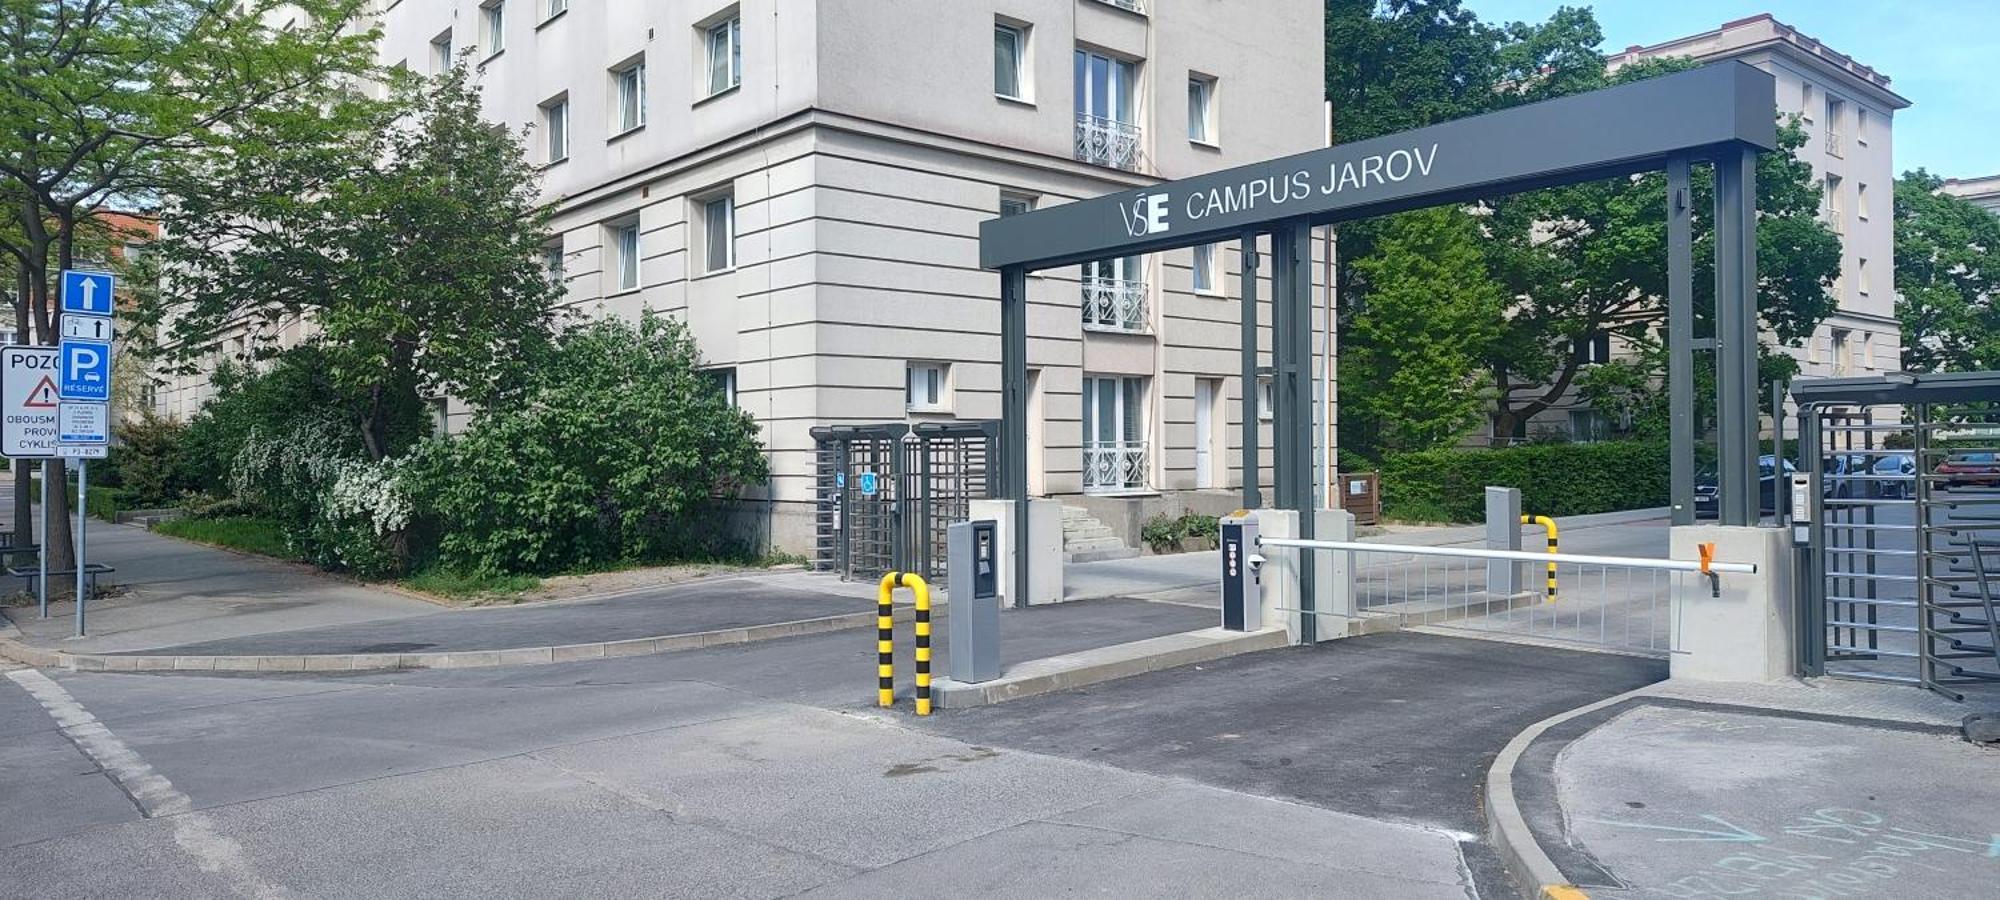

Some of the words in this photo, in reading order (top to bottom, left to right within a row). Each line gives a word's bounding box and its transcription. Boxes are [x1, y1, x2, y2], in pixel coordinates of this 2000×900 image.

[1120, 193, 1169, 237] VŠE
[1186, 170, 1311, 221] CAMPUS
[1321, 144, 1439, 196] JAROV
[70, 347, 100, 381] P
[24, 427, 57, 437] PROV
